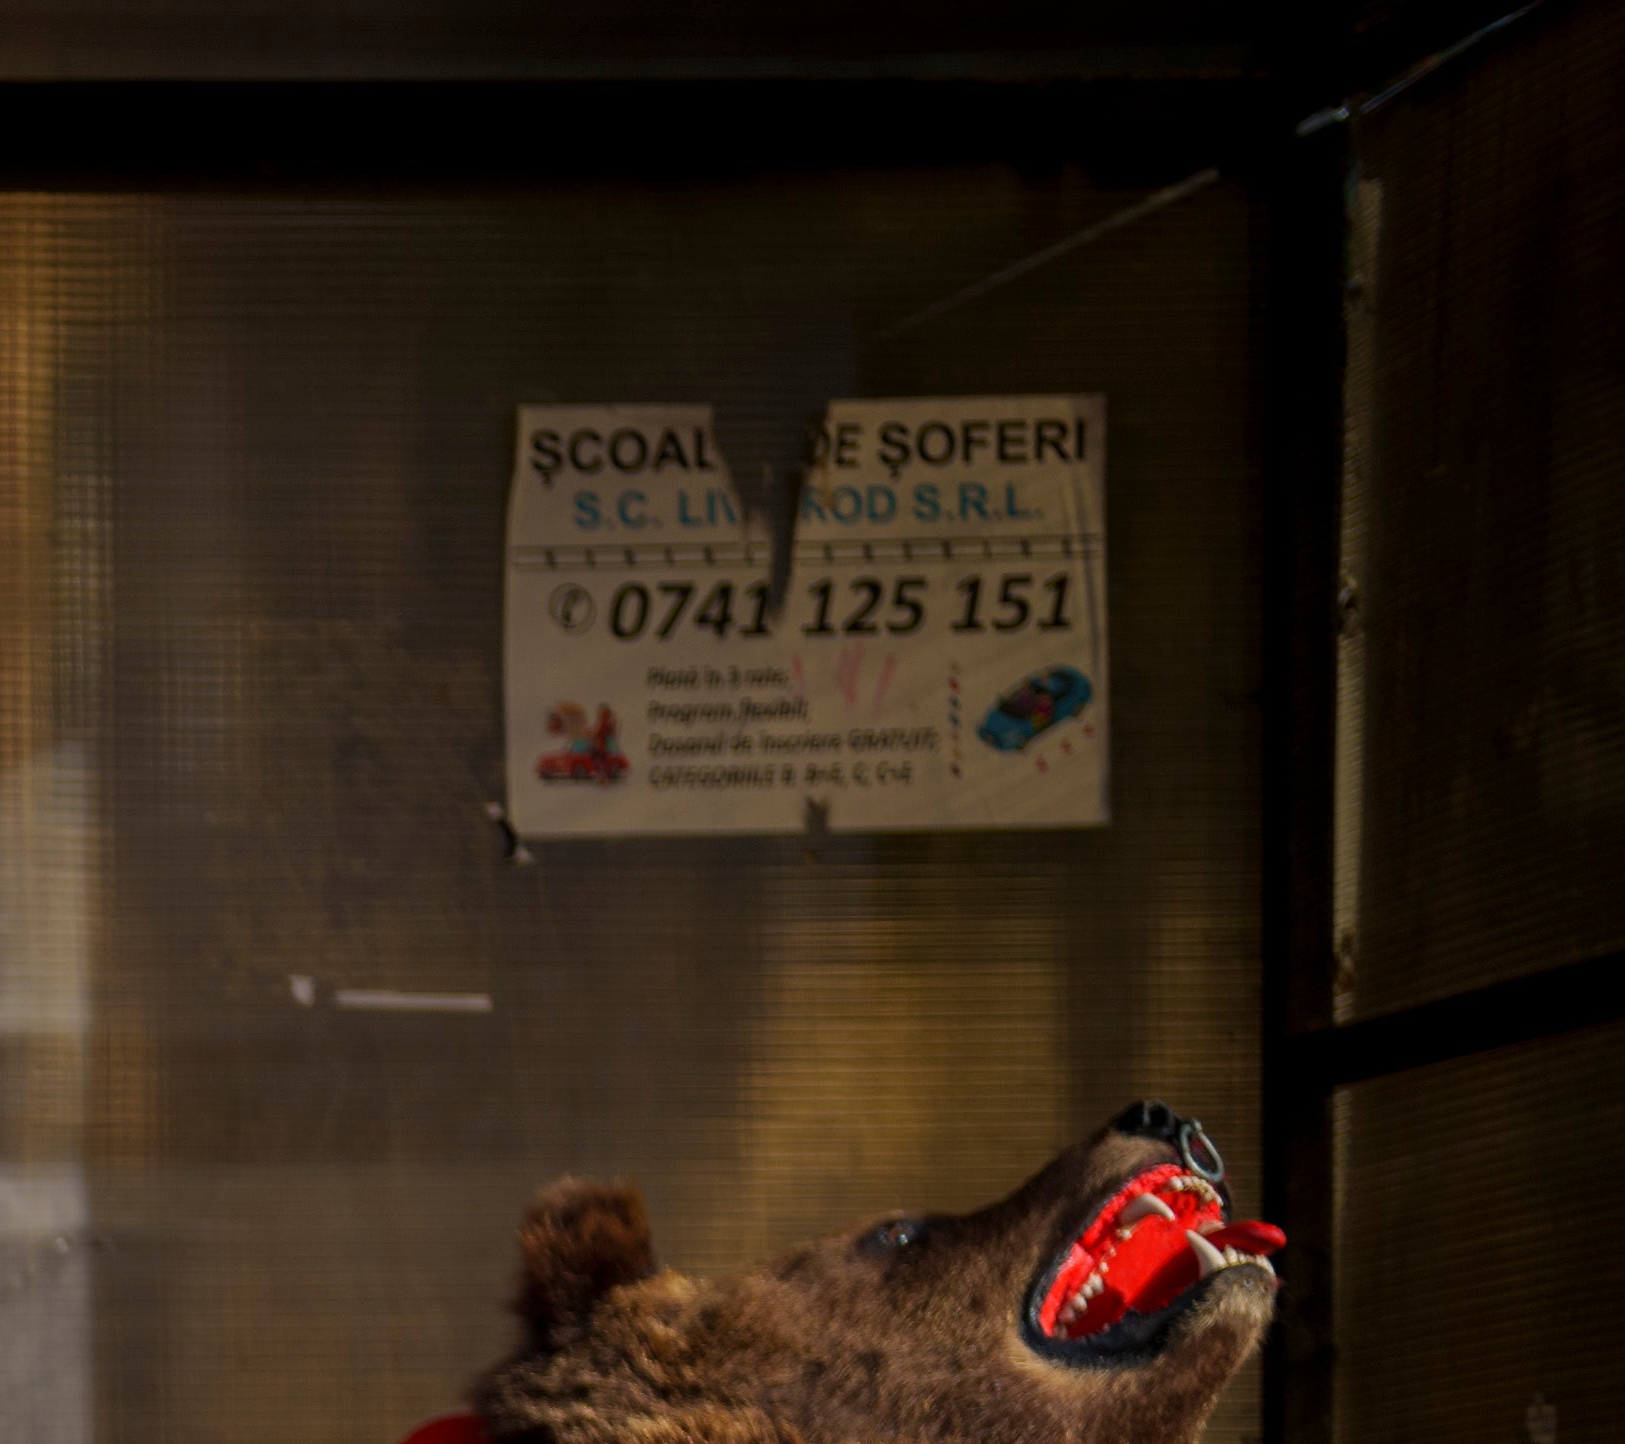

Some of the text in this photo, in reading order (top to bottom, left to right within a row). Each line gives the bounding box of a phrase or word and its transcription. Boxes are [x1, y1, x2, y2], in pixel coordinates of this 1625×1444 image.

[608, 571, 1075, 641] 0741 125 151
